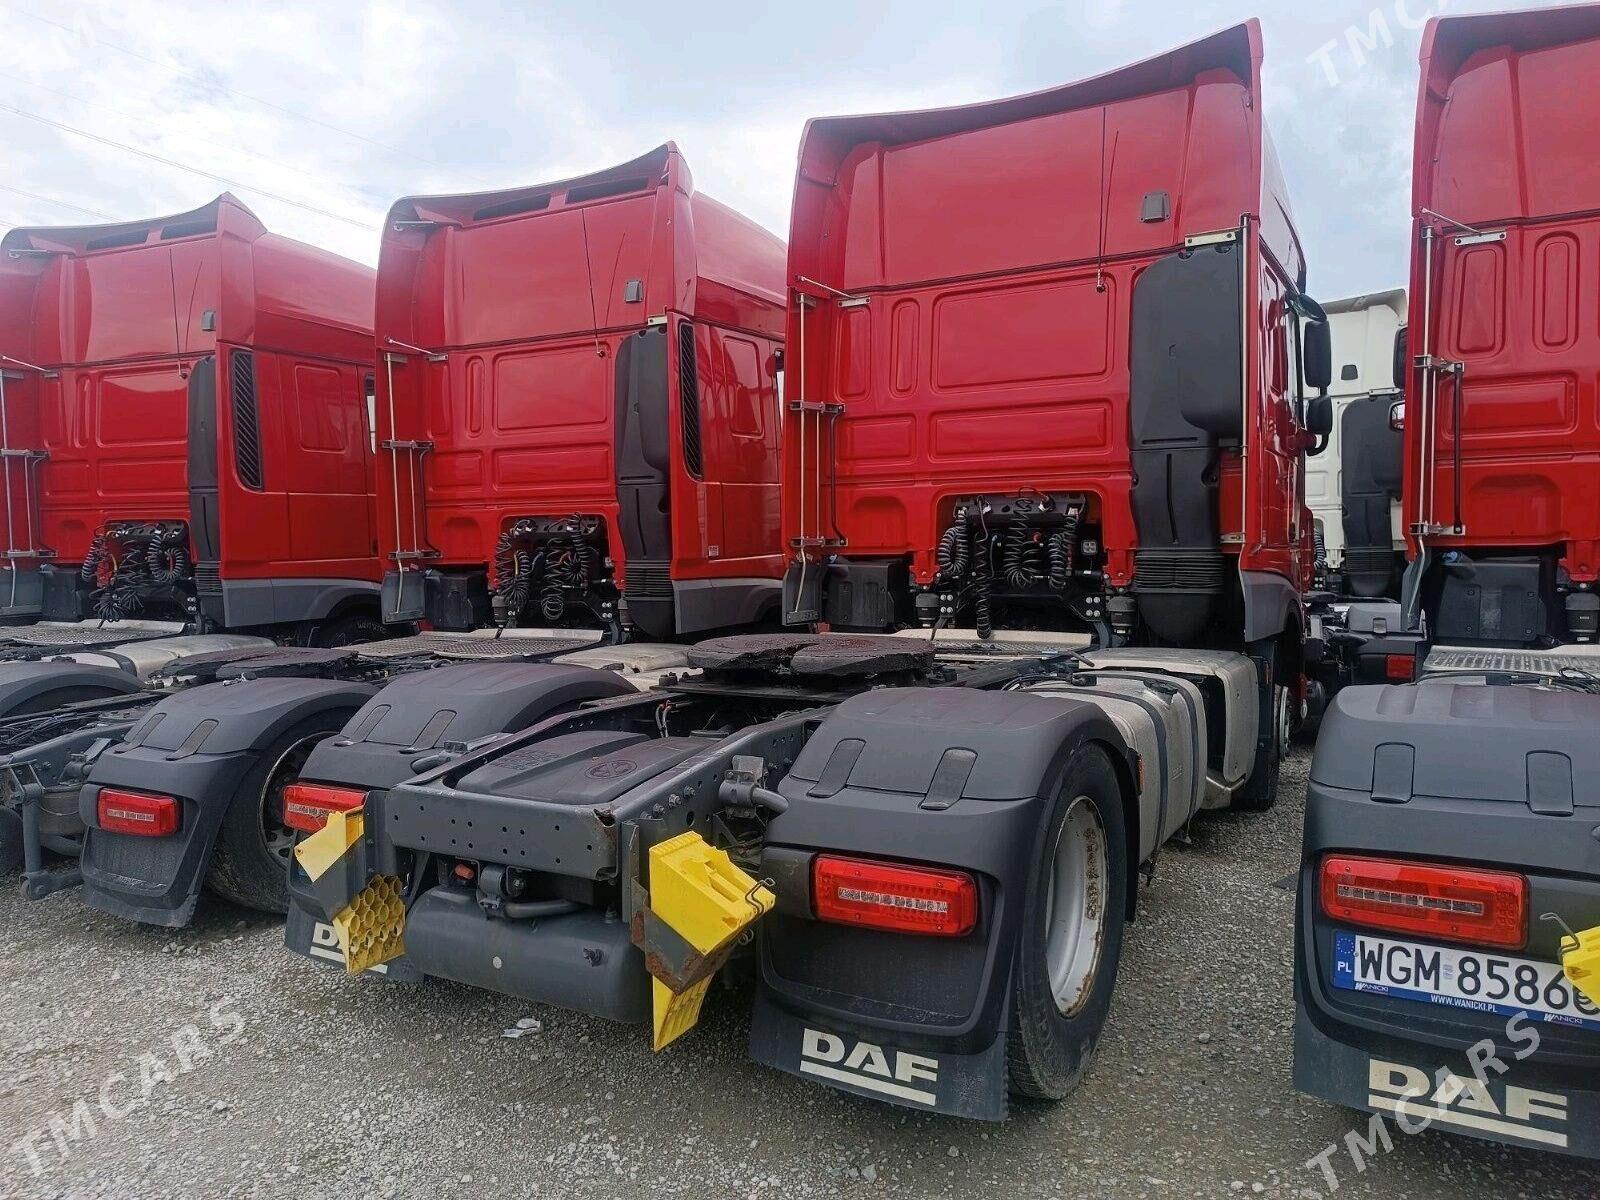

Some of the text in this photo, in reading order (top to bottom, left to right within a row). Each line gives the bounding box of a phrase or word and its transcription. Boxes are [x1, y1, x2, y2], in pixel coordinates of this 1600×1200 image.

[1337, 960, 1352, 973] PL
[1360, 941, 1441, 991] WGM
[1355, 982, 1389, 993] WANICKI
[1430, 993, 1498, 1013] WWW.WANICKI.PL
[1543, 1013, 1583, 1026] WANICKI
[803, 1028, 938, 1082] DAF
[1368, 1058, 1568, 1121] DAF
